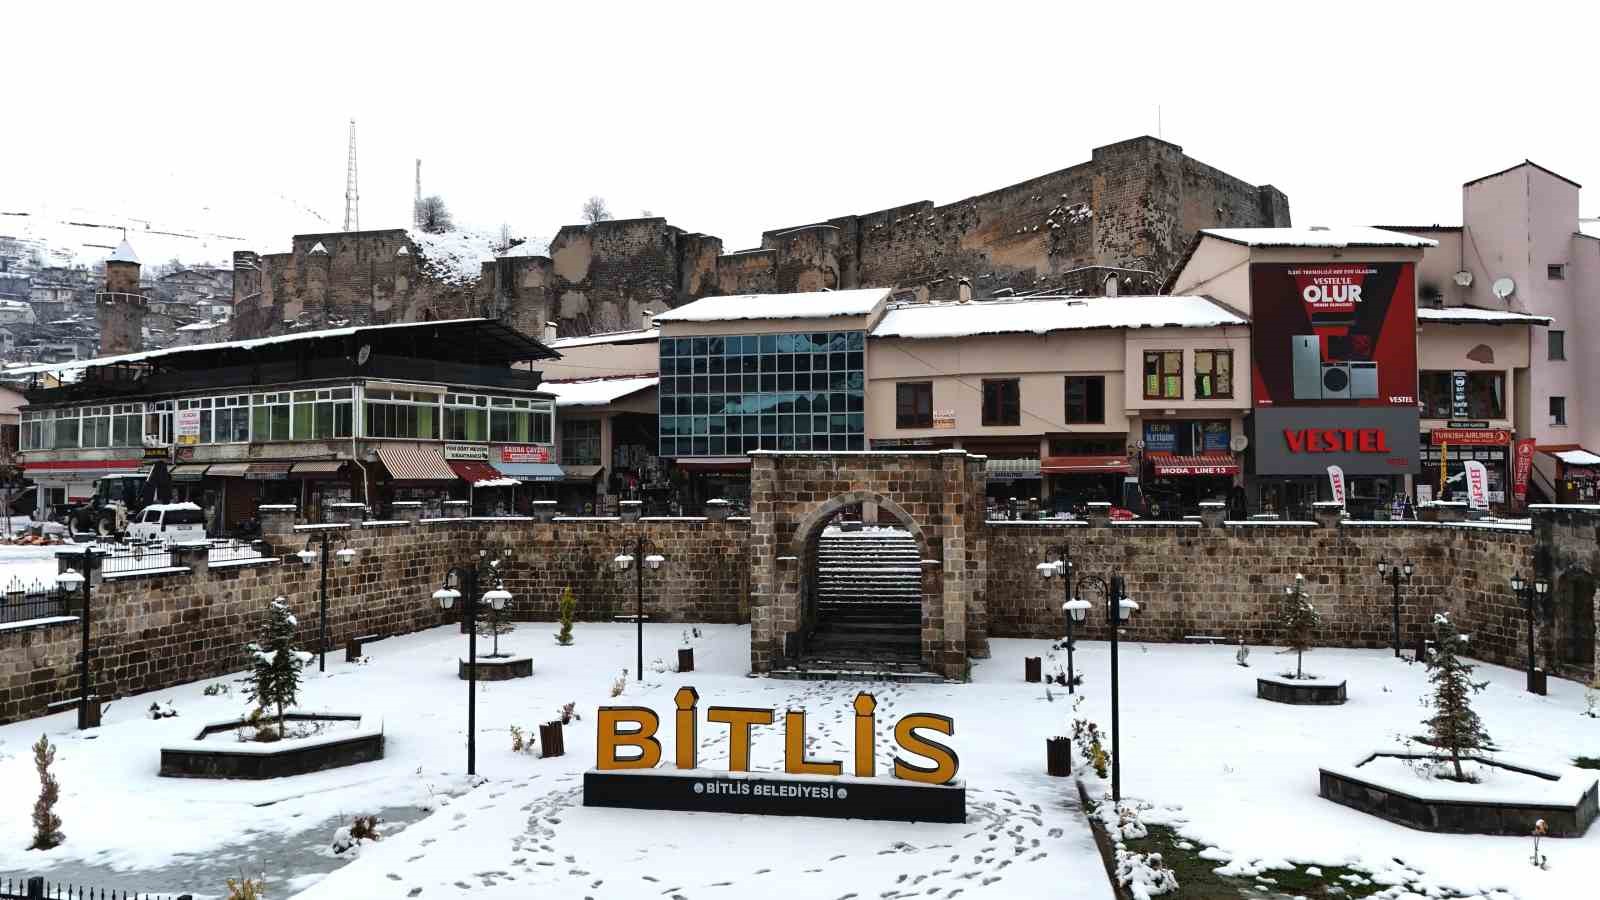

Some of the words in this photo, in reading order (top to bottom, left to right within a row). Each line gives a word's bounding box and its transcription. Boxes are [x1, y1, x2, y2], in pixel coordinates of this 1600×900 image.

[1313, 277, 1353, 285] VESTEL'LE
[1303, 284, 1362, 303] OLUR
[1388, 396, 1414, 404] VESTEL
[1282, 427, 1392, 453] VESTEL
[597, 686, 960, 785] BİTLİS
[706, 780, 750, 794] BİTLİS
[753, 784, 834, 799] BELEDİYESİ
